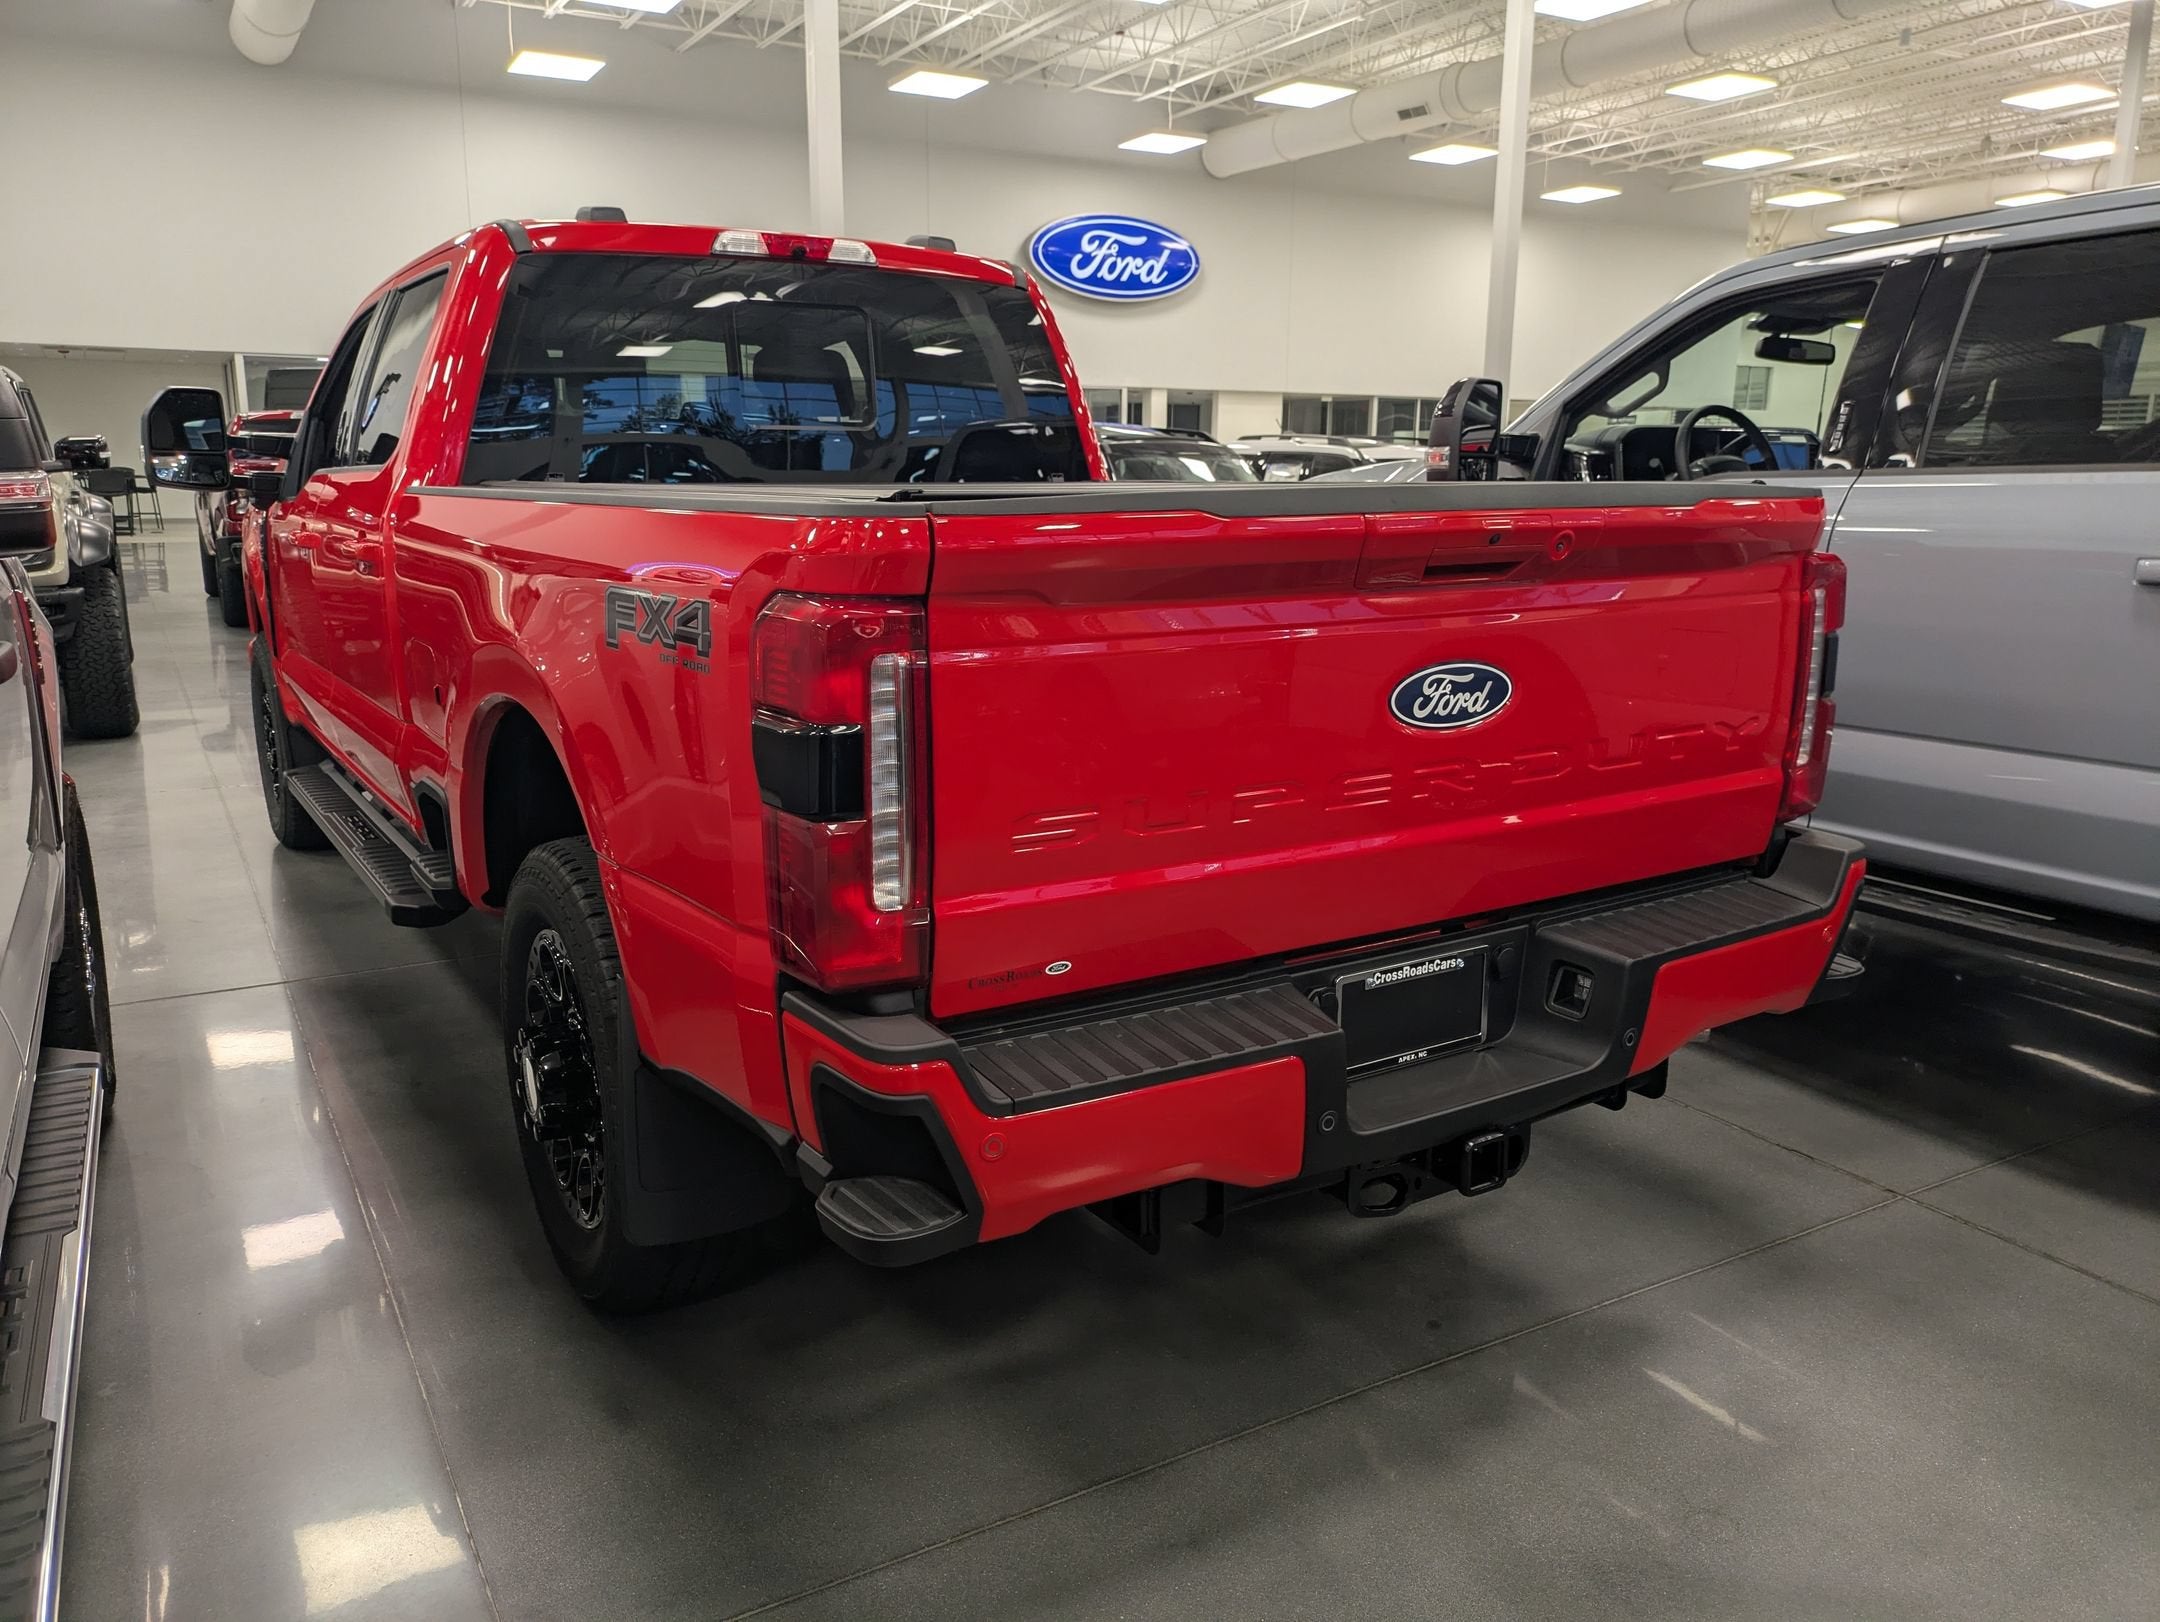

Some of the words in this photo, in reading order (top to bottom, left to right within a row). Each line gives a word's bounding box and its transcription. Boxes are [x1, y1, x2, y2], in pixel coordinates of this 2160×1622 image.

[1069, 229, 1169, 286] Ford
[605, 585, 712, 659] FX4
[659, 653, 680, 665] OFF
[682, 658, 711, 674] ROAD
[1412, 672, 1494, 719] Ford
[1373, 958, 1457, 985] CrossRoadsCars
